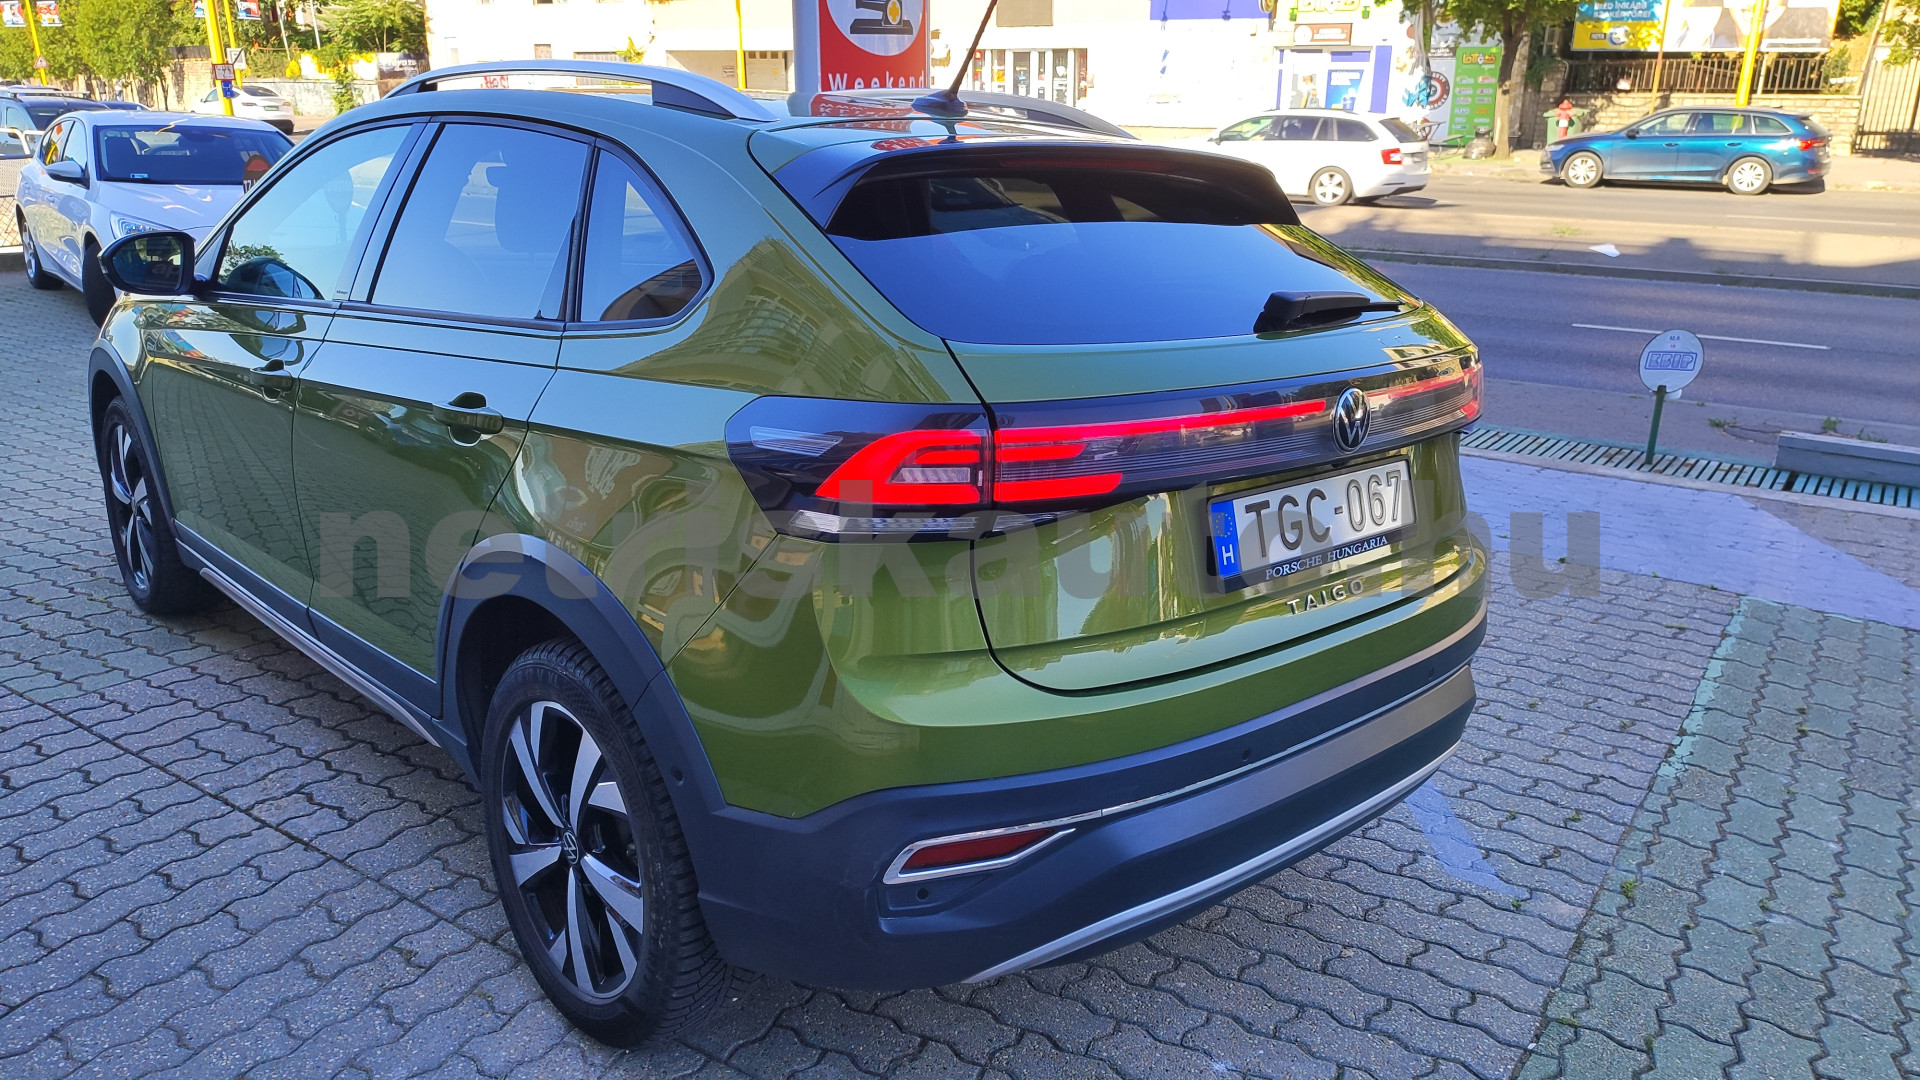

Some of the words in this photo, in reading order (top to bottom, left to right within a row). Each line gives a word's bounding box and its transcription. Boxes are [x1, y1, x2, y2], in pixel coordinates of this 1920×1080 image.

[828, 69, 925, 92] Weekend
[1245, 469, 1401, 558] TGC-067
[1221, 543, 1235, 566] H
[1265, 554, 1323, 580] PORSCHE
[1327, 535, 1388, 561] HUNGARIA
[1284, 577, 1366, 615] TAIGO
